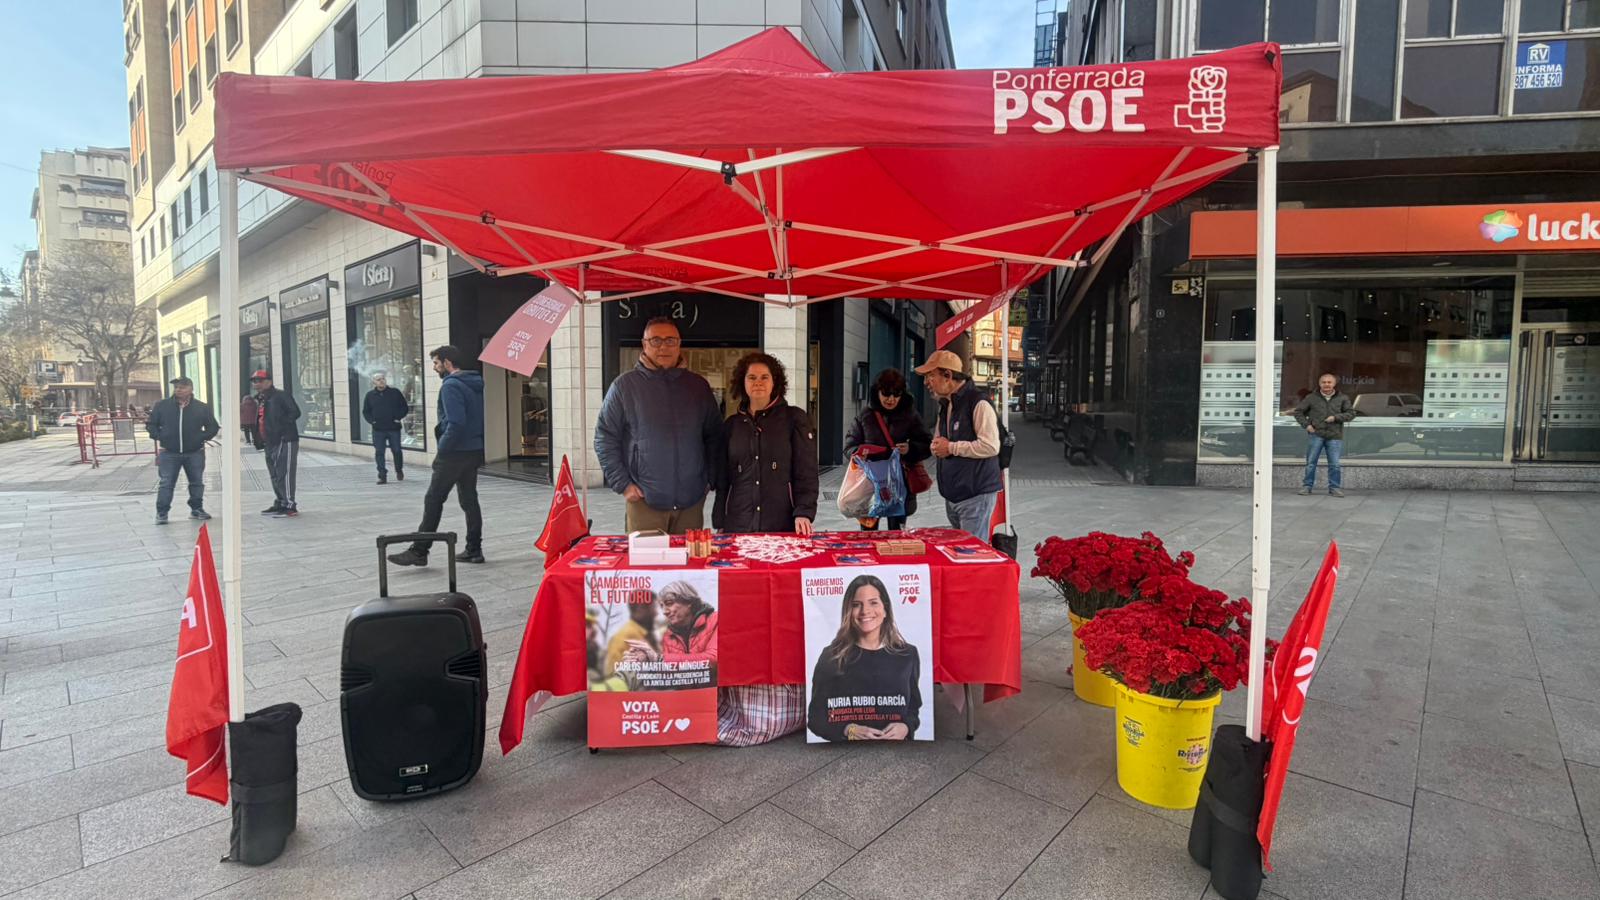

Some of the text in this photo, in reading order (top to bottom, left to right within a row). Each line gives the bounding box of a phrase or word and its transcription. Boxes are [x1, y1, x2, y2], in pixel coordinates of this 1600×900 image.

[1530, 48, 1549, 61] RV
[1515, 64, 1562, 75] INFORMA
[993, 67, 1145, 90] Ponferrada
[1515, 75, 1529, 88] 987
[1547, 73, 1561, 86] 520
[993, 88, 1146, 134] PSOE
[590, 576, 652, 589] CAMBIEMOS
[806, 578, 844, 587] CAMBIEMOS
[591, 590, 653, 604] EL FUTURO
[806, 587, 844, 597] EL FUTURO
[899, 587, 920, 595] PSOE
[614, 661, 642, 672] CARLOS
[642, 660, 678, 672] MARTÍNEZ
[622, 701, 659, 713] VOTA
[828, 694, 906, 708] NURIA RUBIO GARCÍA
[622, 720, 659, 735] PSOE
